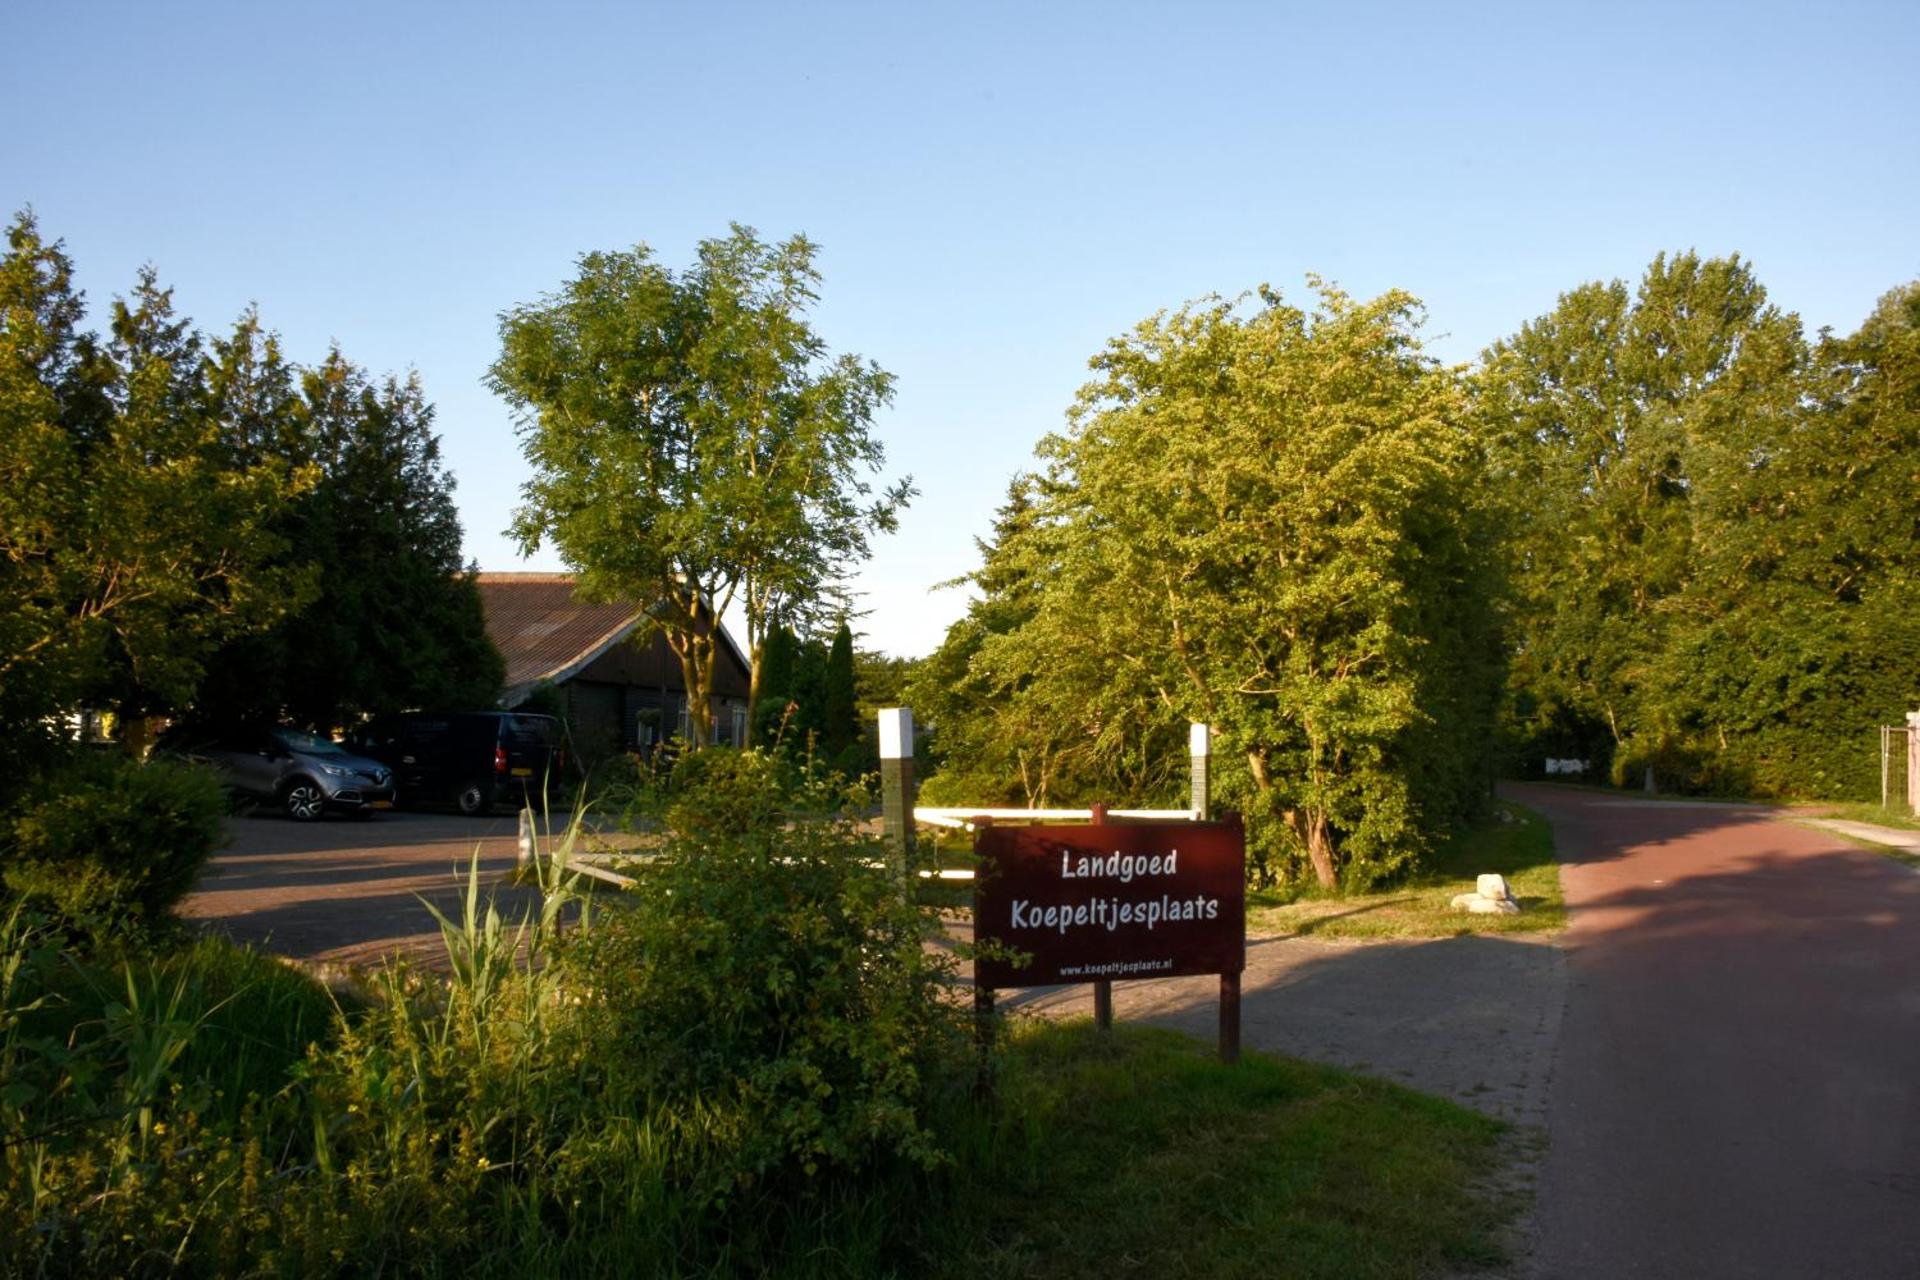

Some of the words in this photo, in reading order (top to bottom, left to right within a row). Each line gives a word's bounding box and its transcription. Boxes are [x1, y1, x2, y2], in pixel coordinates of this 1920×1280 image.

[1061, 849, 1177, 883] Landgoed
[1011, 895, 1219, 934] Koepeltjesplaats
[1060, 958, 1172, 976] www.koepeltjesplaats.nl
